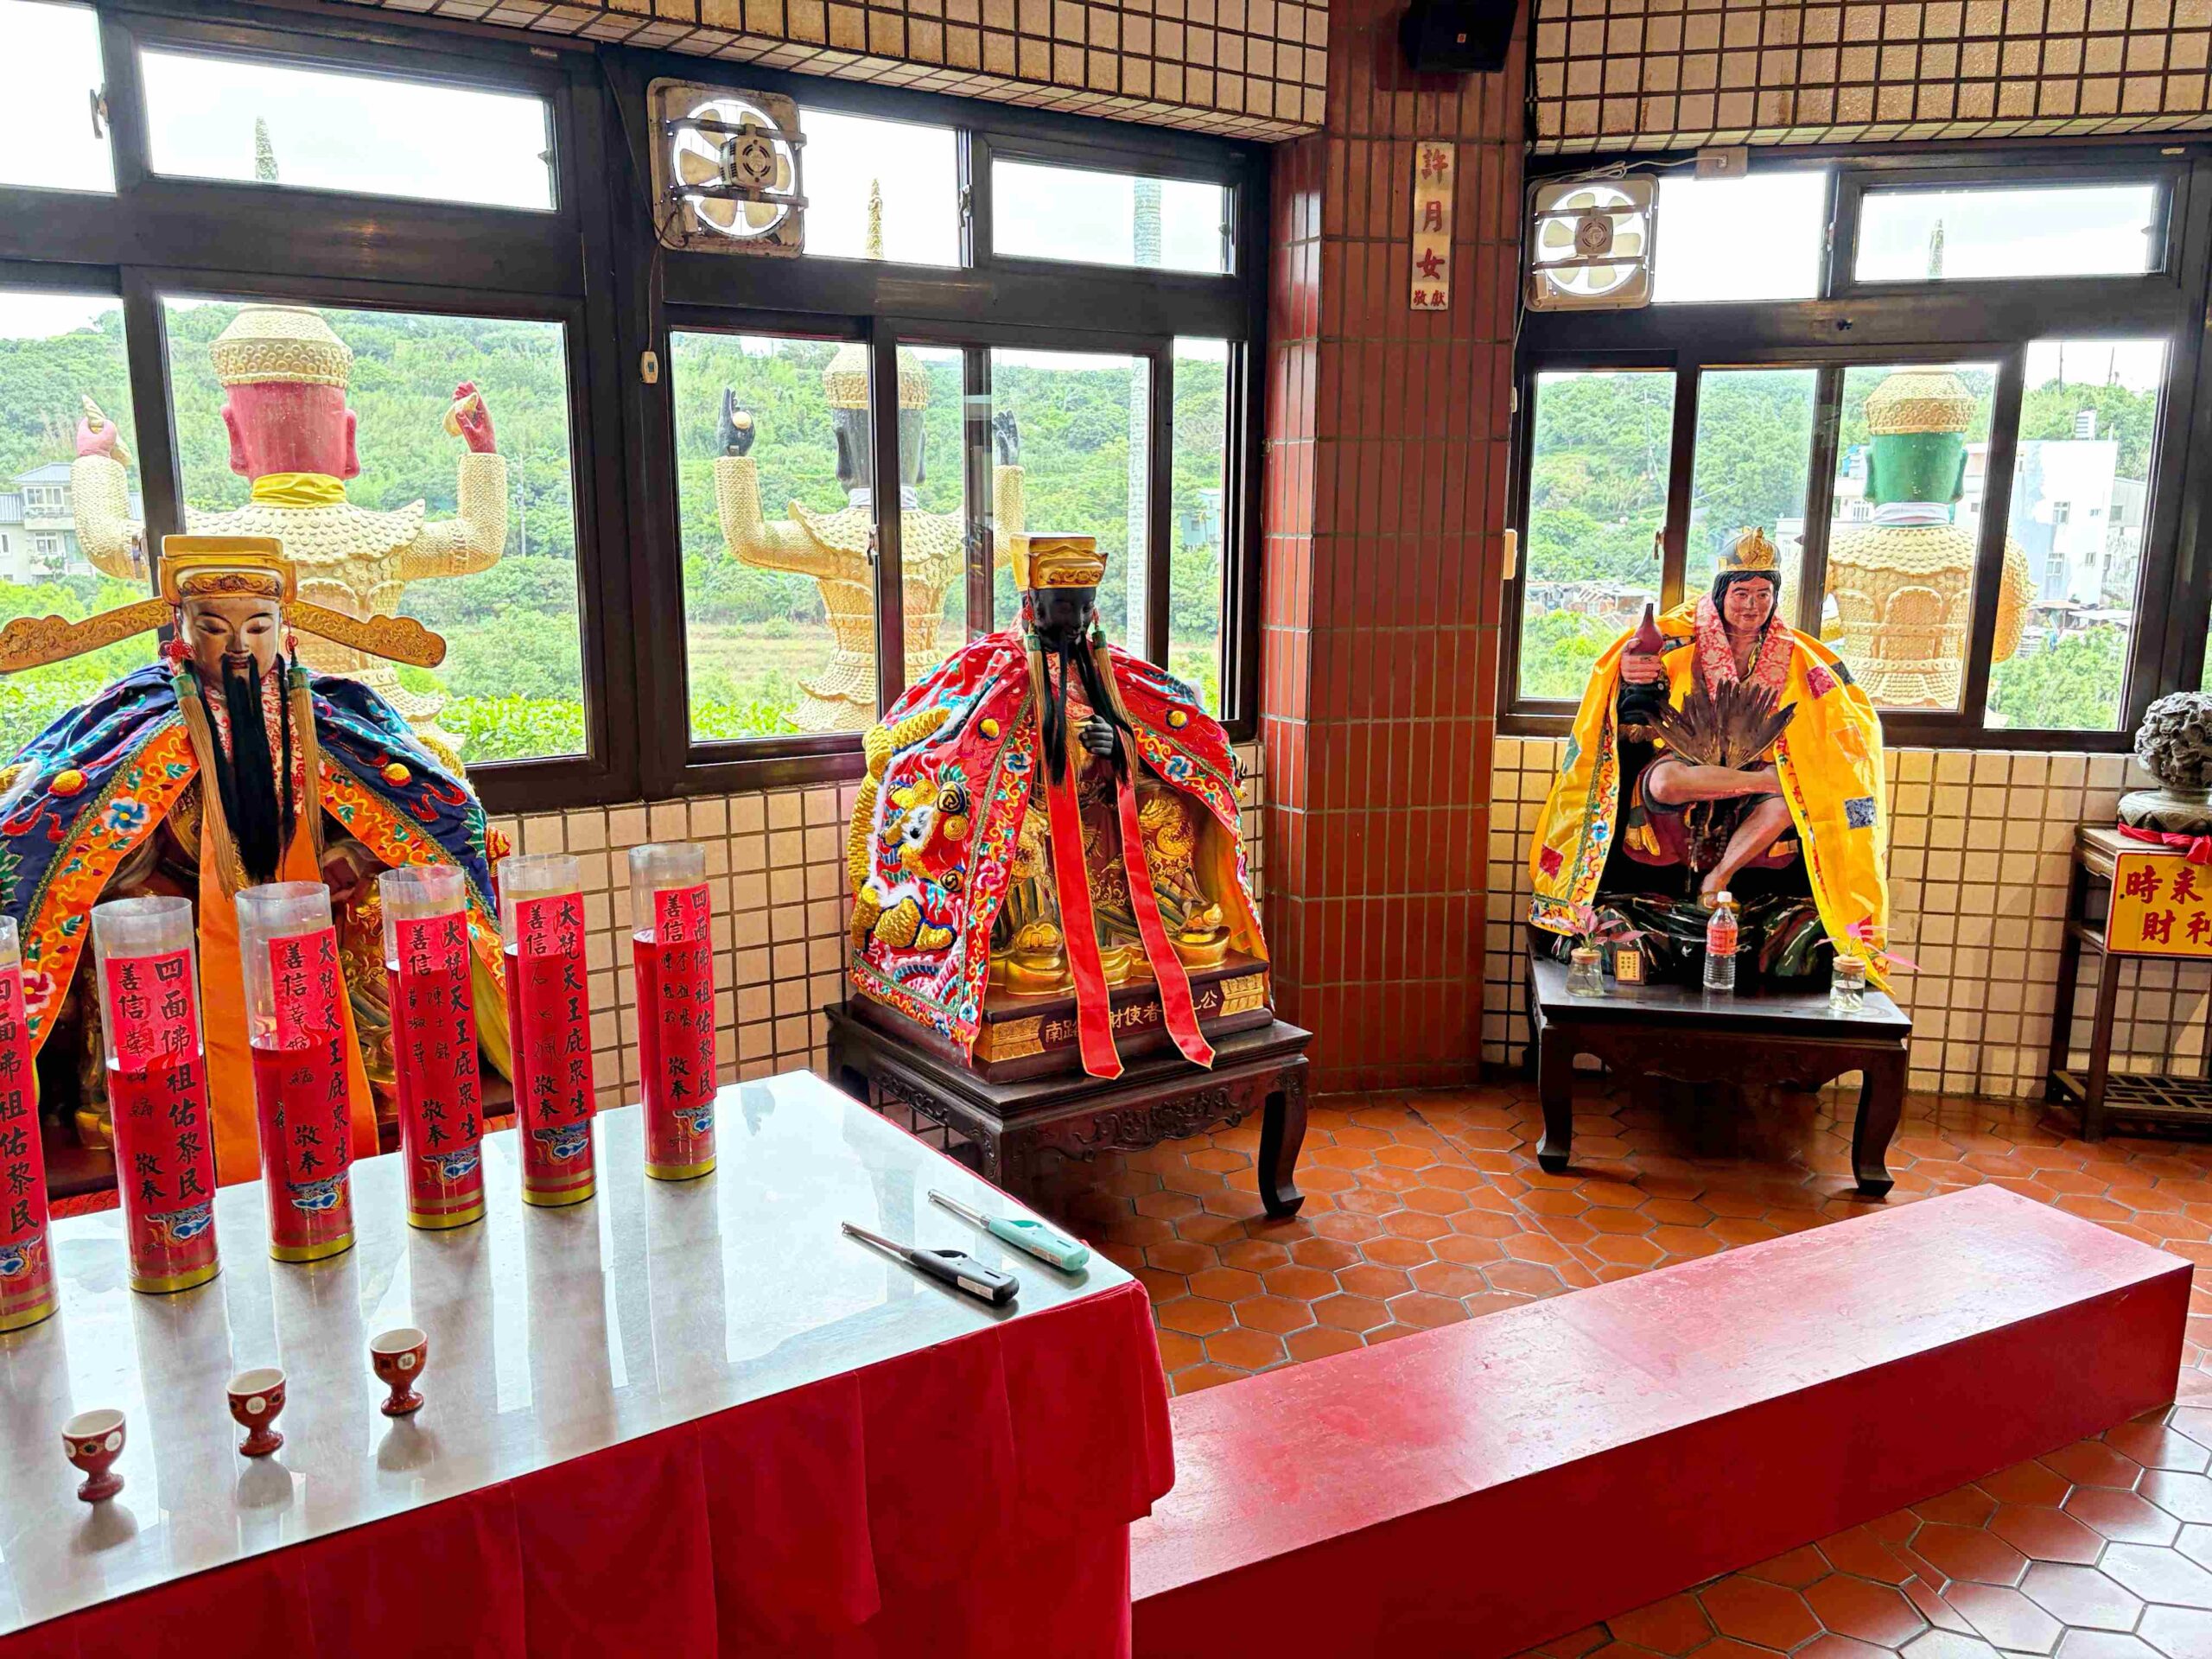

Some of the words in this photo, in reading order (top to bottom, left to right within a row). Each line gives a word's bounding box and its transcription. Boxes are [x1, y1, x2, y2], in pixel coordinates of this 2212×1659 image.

[1415, 148, 1449, 280] 許月女
[1413, 289, 1446, 307] 敬獻
[524, 903, 548, 956] 善信
[662, 893, 684, 943] 善信
[2141, 909, 2212, 948] 財利
[282, 941, 308, 998] 善信
[408, 924, 432, 977] 善信
[118, 963, 143, 1020] 善信
[691, 888, 714, 1098] 四面佛祖佑黎民
[154, 957, 207, 1201] 四面佛祖佑黎民
[533, 1073, 562, 1122] 敬奉
[667, 1055, 691, 1103] 敬奉
[421, 1097, 452, 1149] 敬奉
[294, 1125, 324, 1177] 敬奉
[135, 1152, 168, 1205] 敬奉
